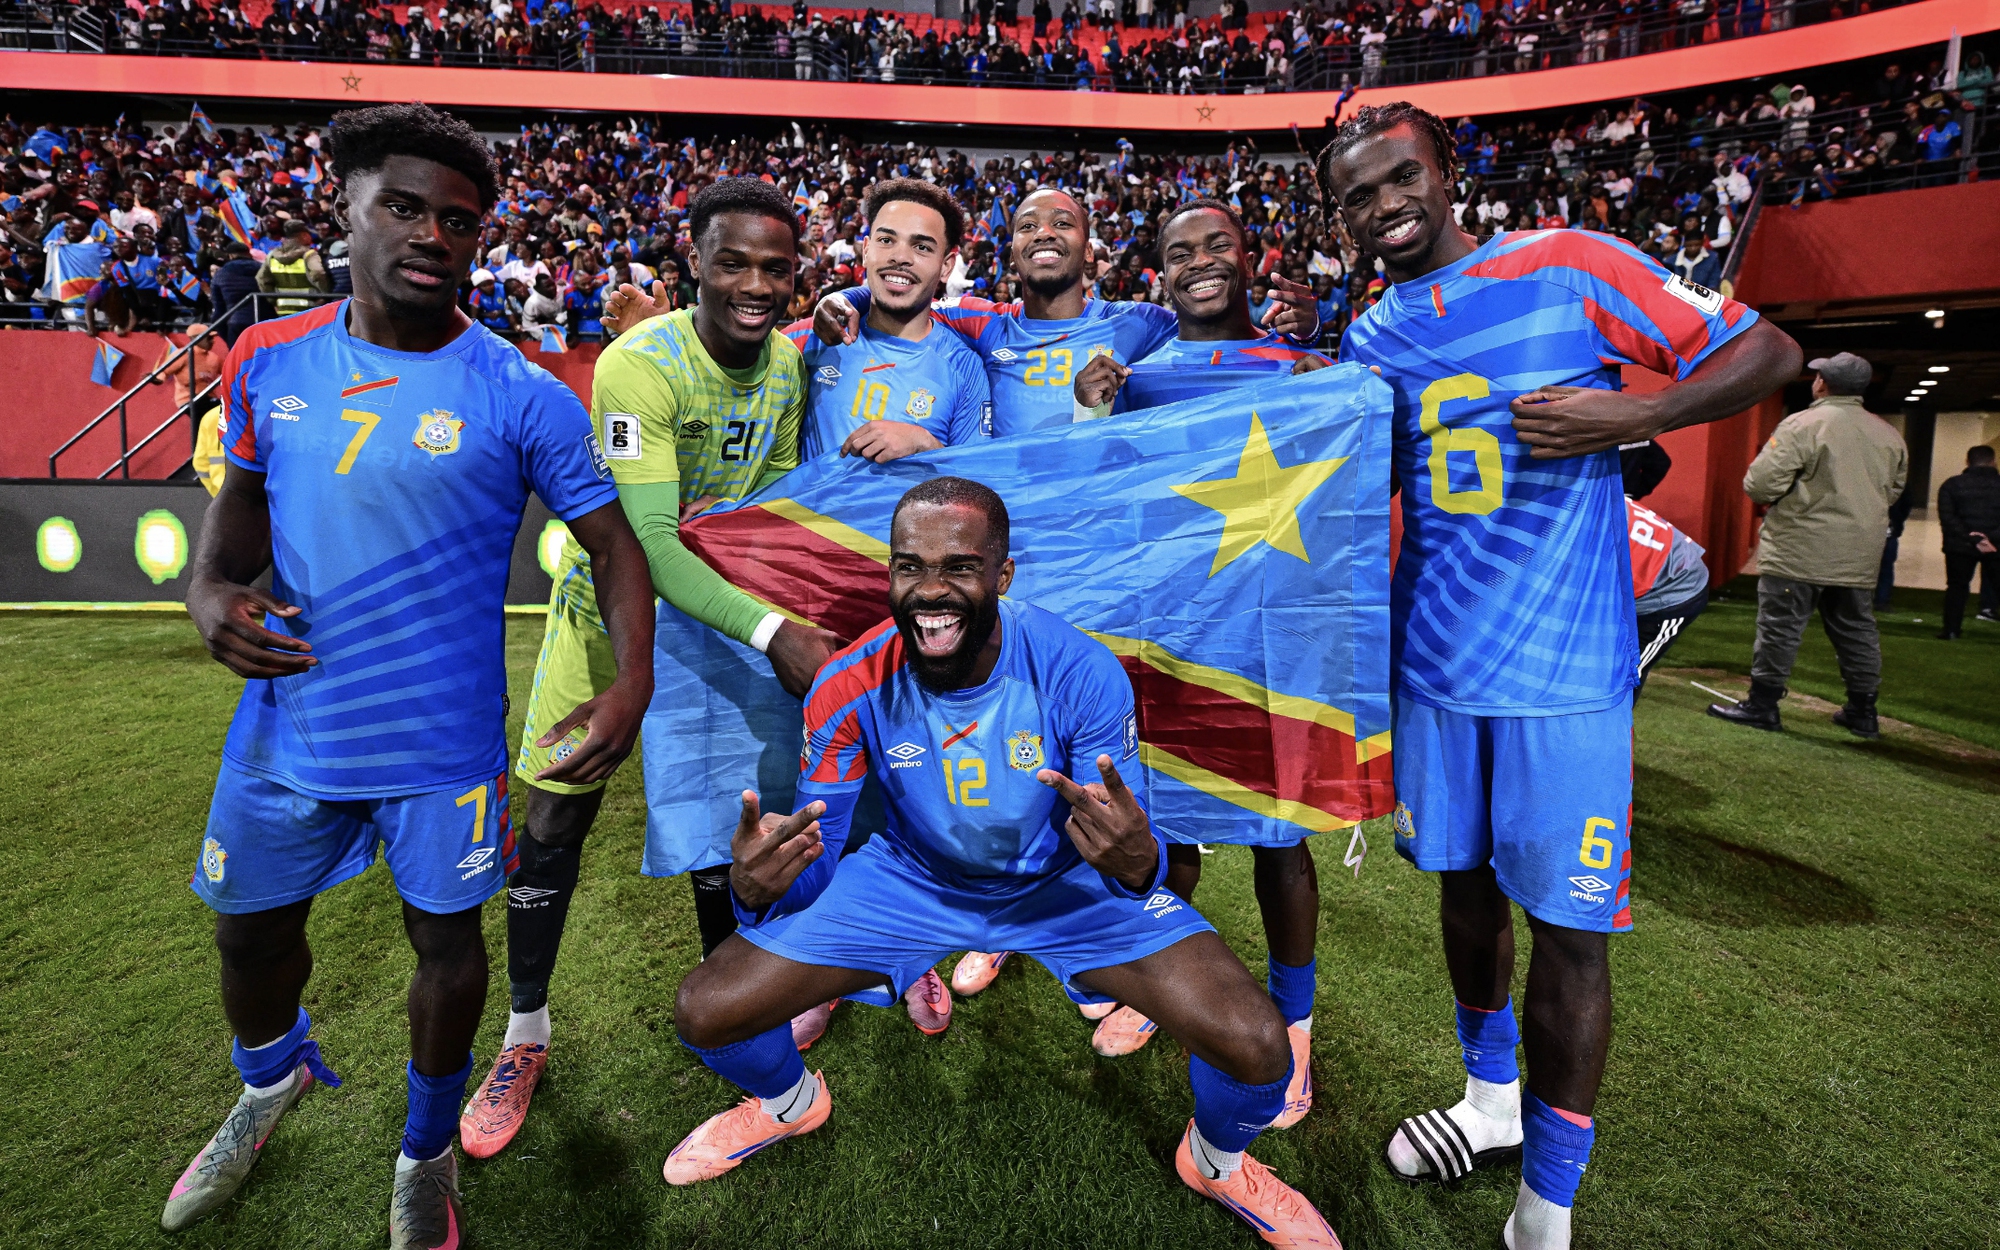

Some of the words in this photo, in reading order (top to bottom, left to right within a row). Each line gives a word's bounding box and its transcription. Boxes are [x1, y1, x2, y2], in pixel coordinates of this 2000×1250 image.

[817, 376, 838, 387] umbro
[1024, 348, 1073, 386] 23
[270, 411, 300, 422] umbro
[850, 378, 891, 421] 10
[334, 408, 382, 475] 7
[420, 440, 451, 451] FECOFA
[721, 420, 756, 461] 21
[1419, 372, 1503, 516] 6
[1628, 500, 1668, 551] PH
[890, 760, 923, 769] umbro
[941, 758, 990, 807] 12
[455, 784, 488, 844] 7
[1579, 816, 1616, 870] 6
[461, 860, 494, 881] umbro
[1153, 904, 1183, 919] umbro
[1569, 889, 1605, 904] umbro
